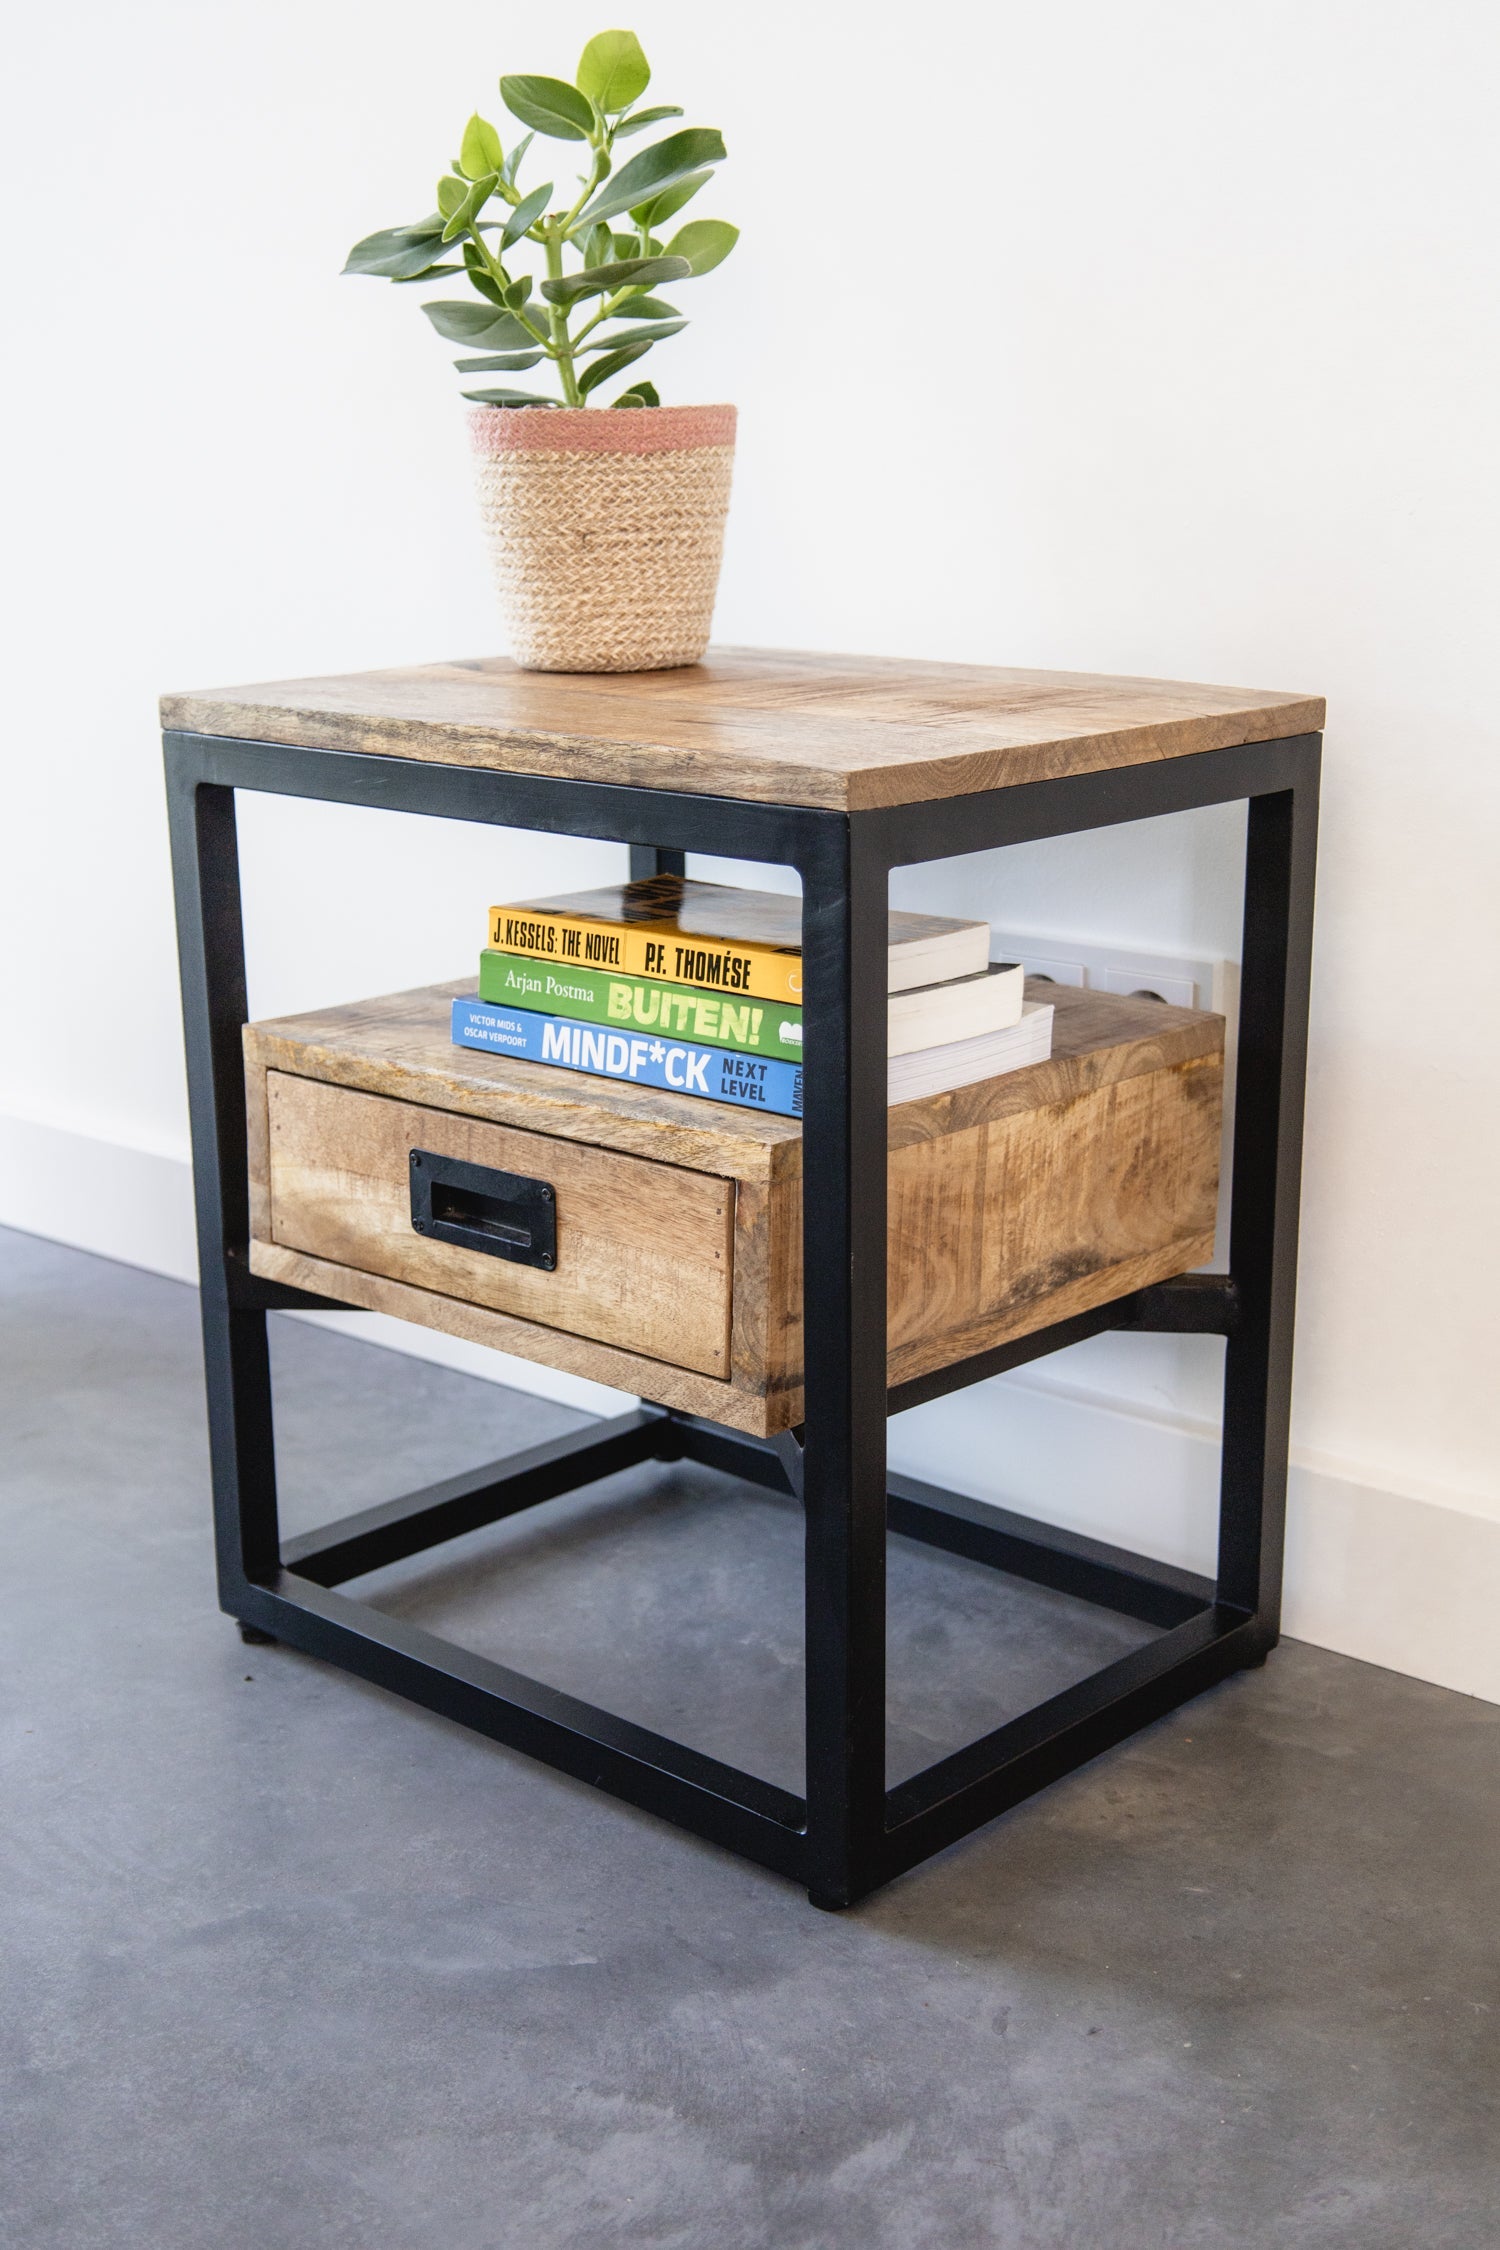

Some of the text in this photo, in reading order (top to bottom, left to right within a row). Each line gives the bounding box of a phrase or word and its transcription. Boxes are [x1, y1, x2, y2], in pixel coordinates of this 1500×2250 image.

[494, 918, 620, 965] J. KESSELS: THE NOVEL
[645, 943, 752, 990] P.F. THOMÉSE
[505, 970, 594, 1002] Arjan Postma
[469, 1013, 522, 1032] VICTOR MIDS &
[607, 982, 764, 1046] BUITEN!
[464, 1027, 527, 1048] OSCAR VERPOORT
[722, 1058, 768, 1082] NEXT
[721, 1078, 766, 1102] LEVEL
